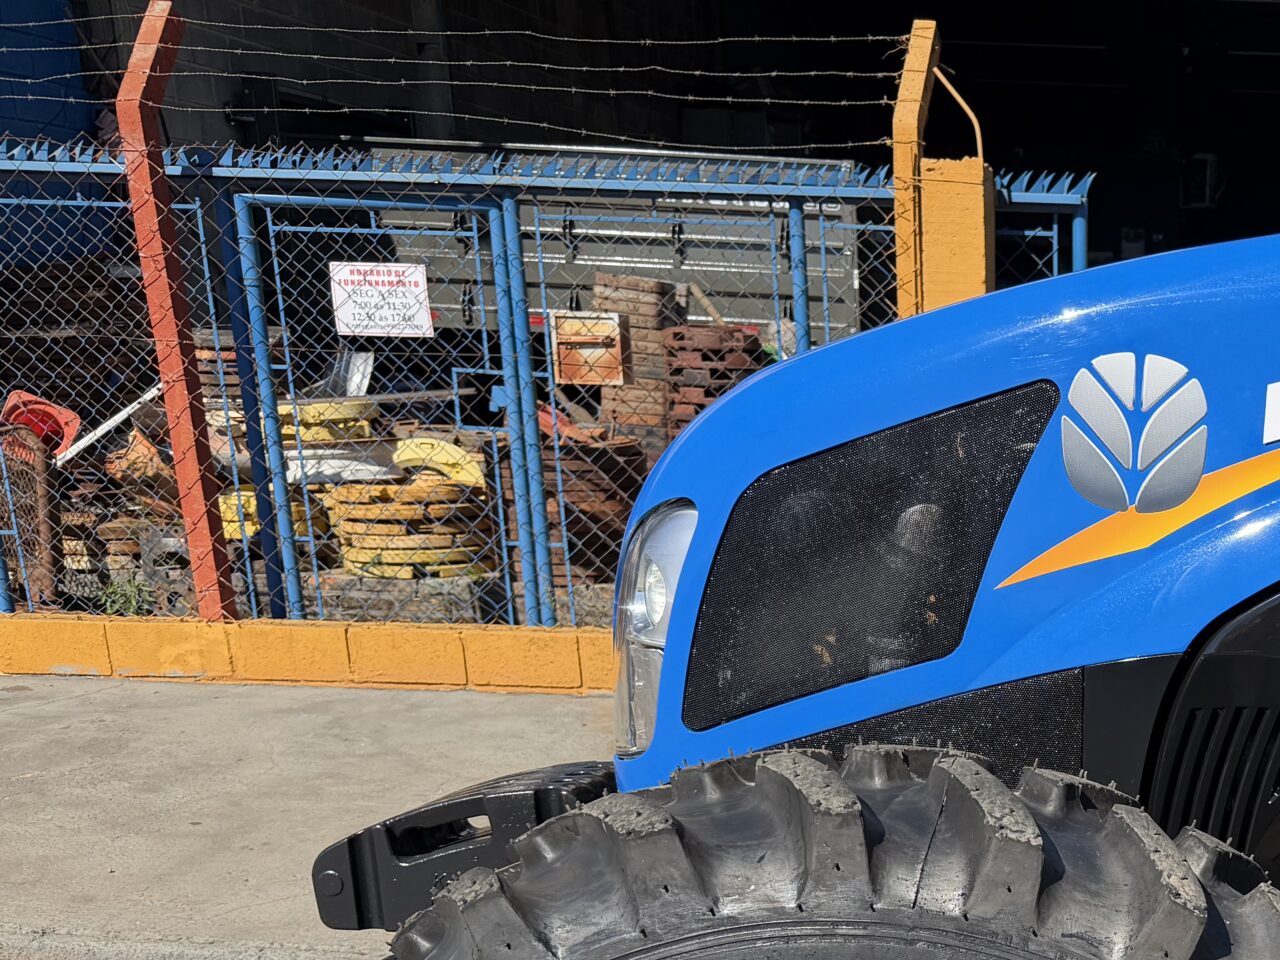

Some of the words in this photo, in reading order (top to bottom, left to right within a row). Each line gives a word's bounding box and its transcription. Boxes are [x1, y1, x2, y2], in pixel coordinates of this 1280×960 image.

[352, 289, 374, 298] SEG
[378, 290, 385, 298] A
[386, 290, 408, 299] SEX
